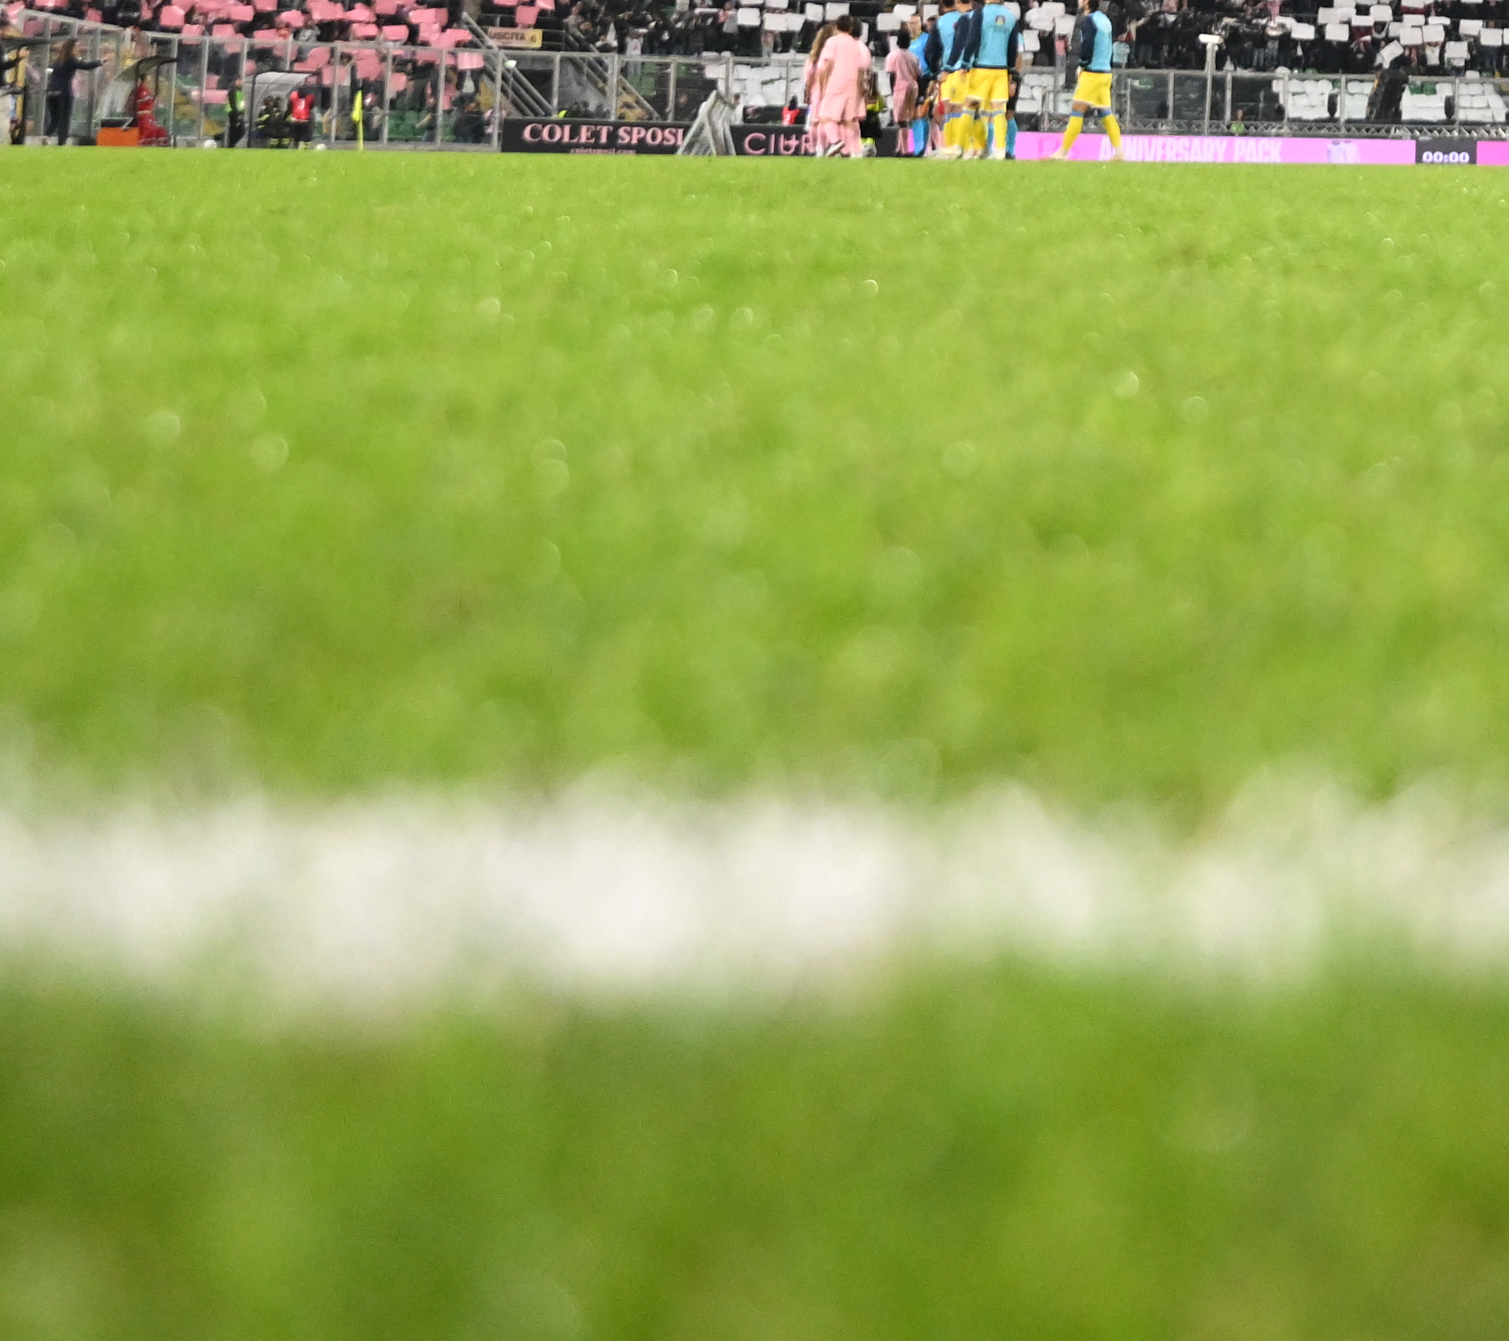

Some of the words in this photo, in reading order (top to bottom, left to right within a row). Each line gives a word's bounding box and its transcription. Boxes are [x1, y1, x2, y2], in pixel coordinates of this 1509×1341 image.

[522, 123, 613, 145] COLET
[618, 126, 684, 146] SPOSI
[1234, 138, 1282, 163] PACK
[1422, 150, 1470, 164] 00:00
